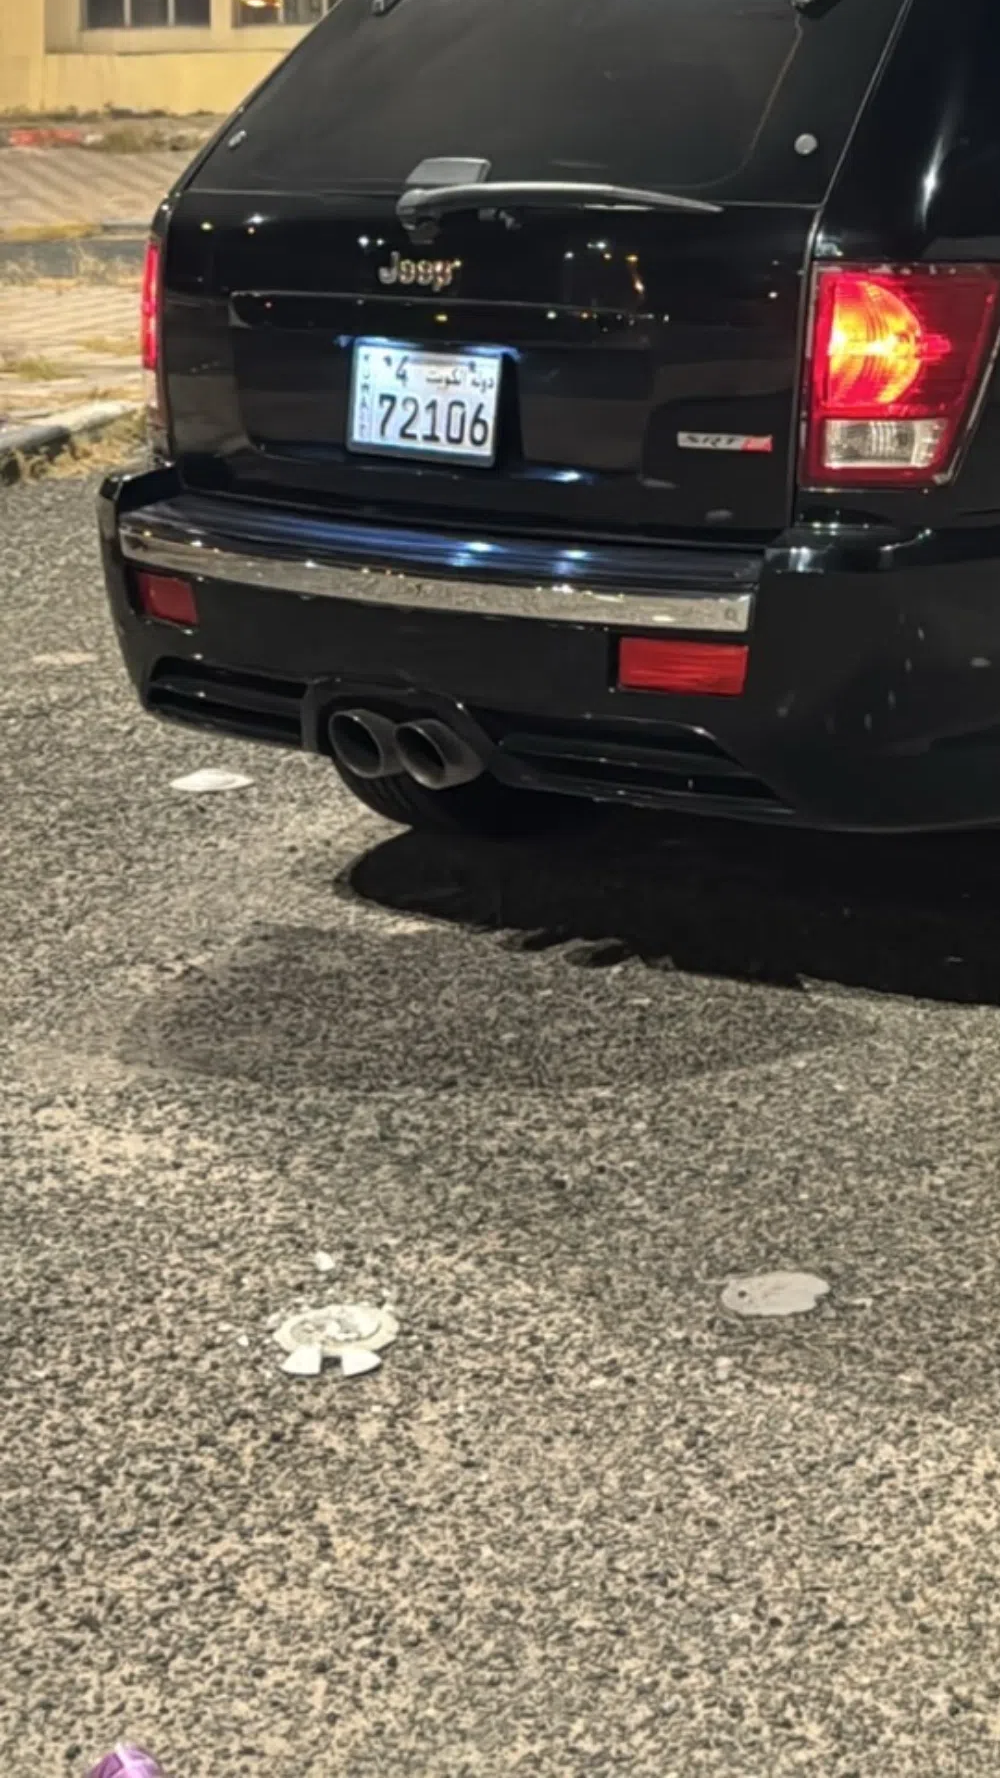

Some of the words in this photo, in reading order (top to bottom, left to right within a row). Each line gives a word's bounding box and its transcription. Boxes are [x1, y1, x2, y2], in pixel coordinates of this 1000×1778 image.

[378, 250, 462, 292] Jeep
[395, 355, 409, 386] 4
[377, 393, 489, 446] 72106
